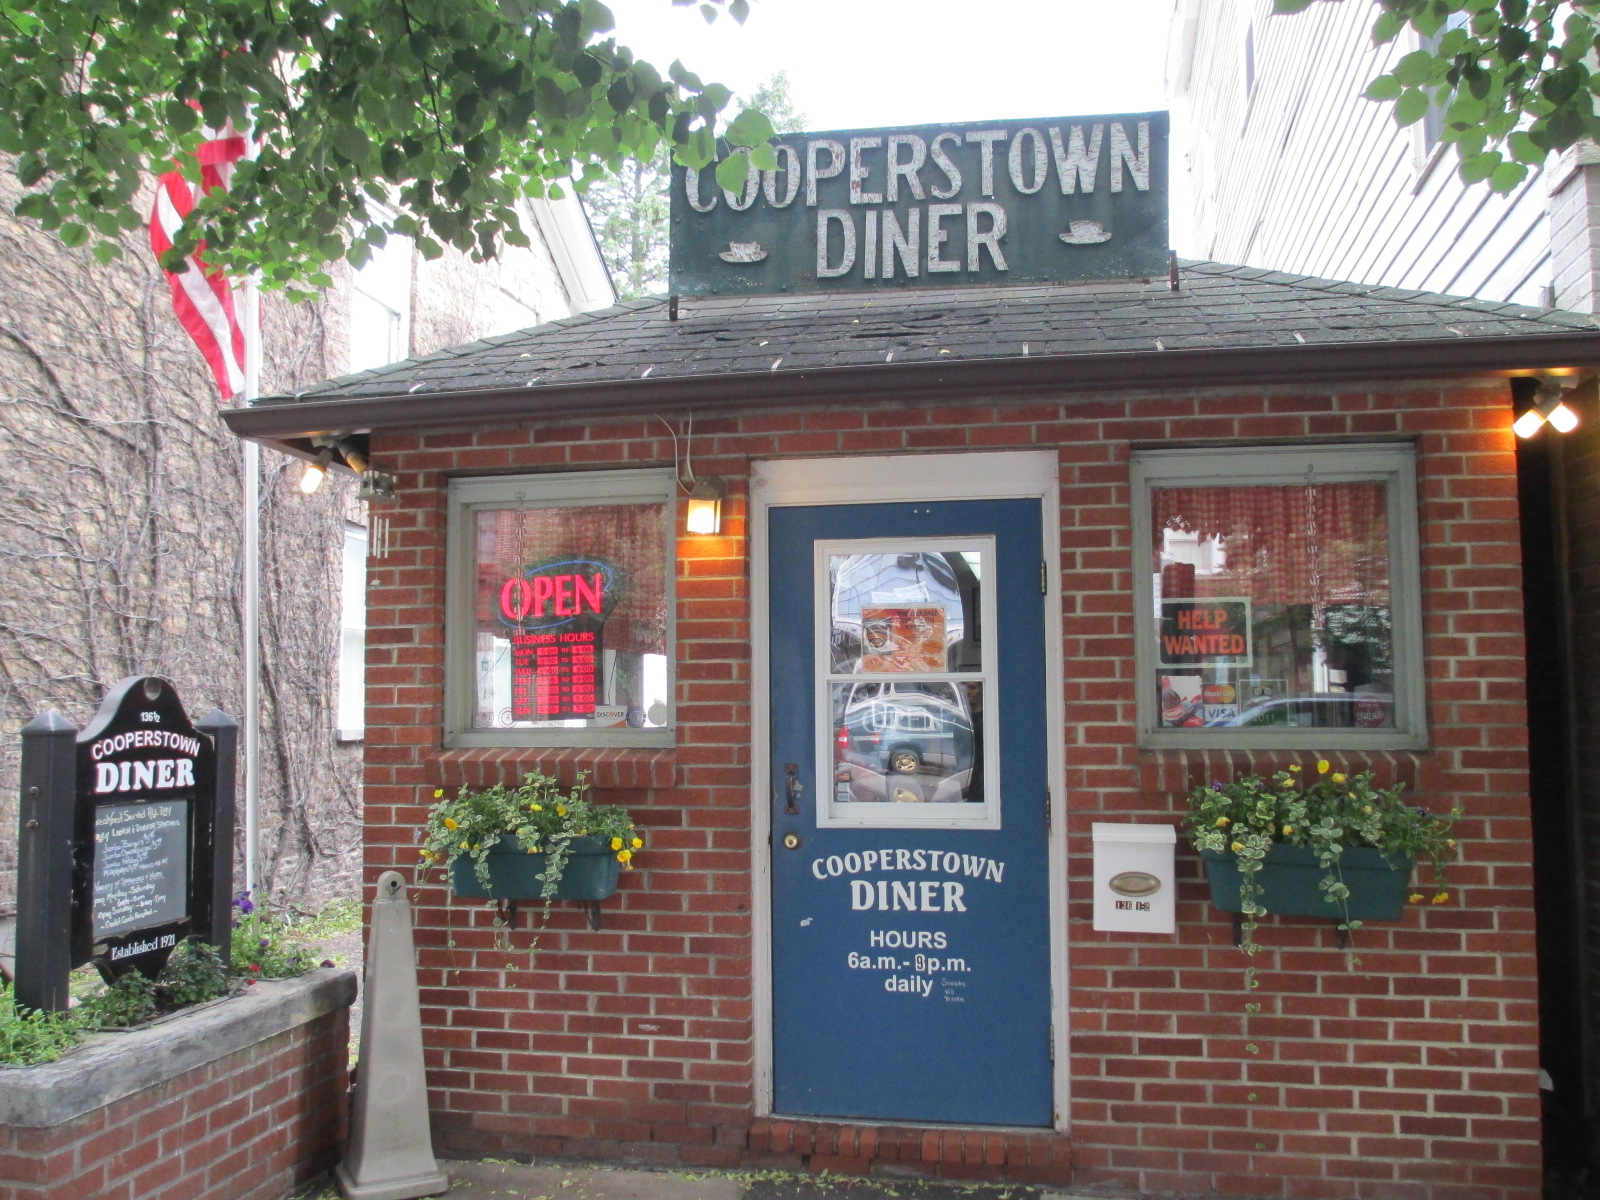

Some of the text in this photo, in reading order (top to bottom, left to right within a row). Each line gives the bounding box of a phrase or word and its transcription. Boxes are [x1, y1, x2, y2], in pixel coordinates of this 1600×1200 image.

[685, 121, 1151, 212] COOPERSTOWN
[816, 203, 1009, 279] DINER
[501, 573, 603, 619] OPEN
[1178, 609, 1228, 629] HELP
[513, 632, 595, 644] BUSINESS HOURS
[1163, 634, 1245, 655] WANTED
[1208, 708, 1236, 718] VISA
[92, 730, 201, 760] COOPERSTOWN
[95, 759, 196, 793] DINER
[812, 849, 1005, 883] COOPERSTOWN
[850, 880, 967, 912] DINER
[1115, 900, 1132, 911] 136
[112, 934, 176, 960] Established 1921
[870, 930, 947, 948] HOURS
[885, 975, 933, 997] daily
